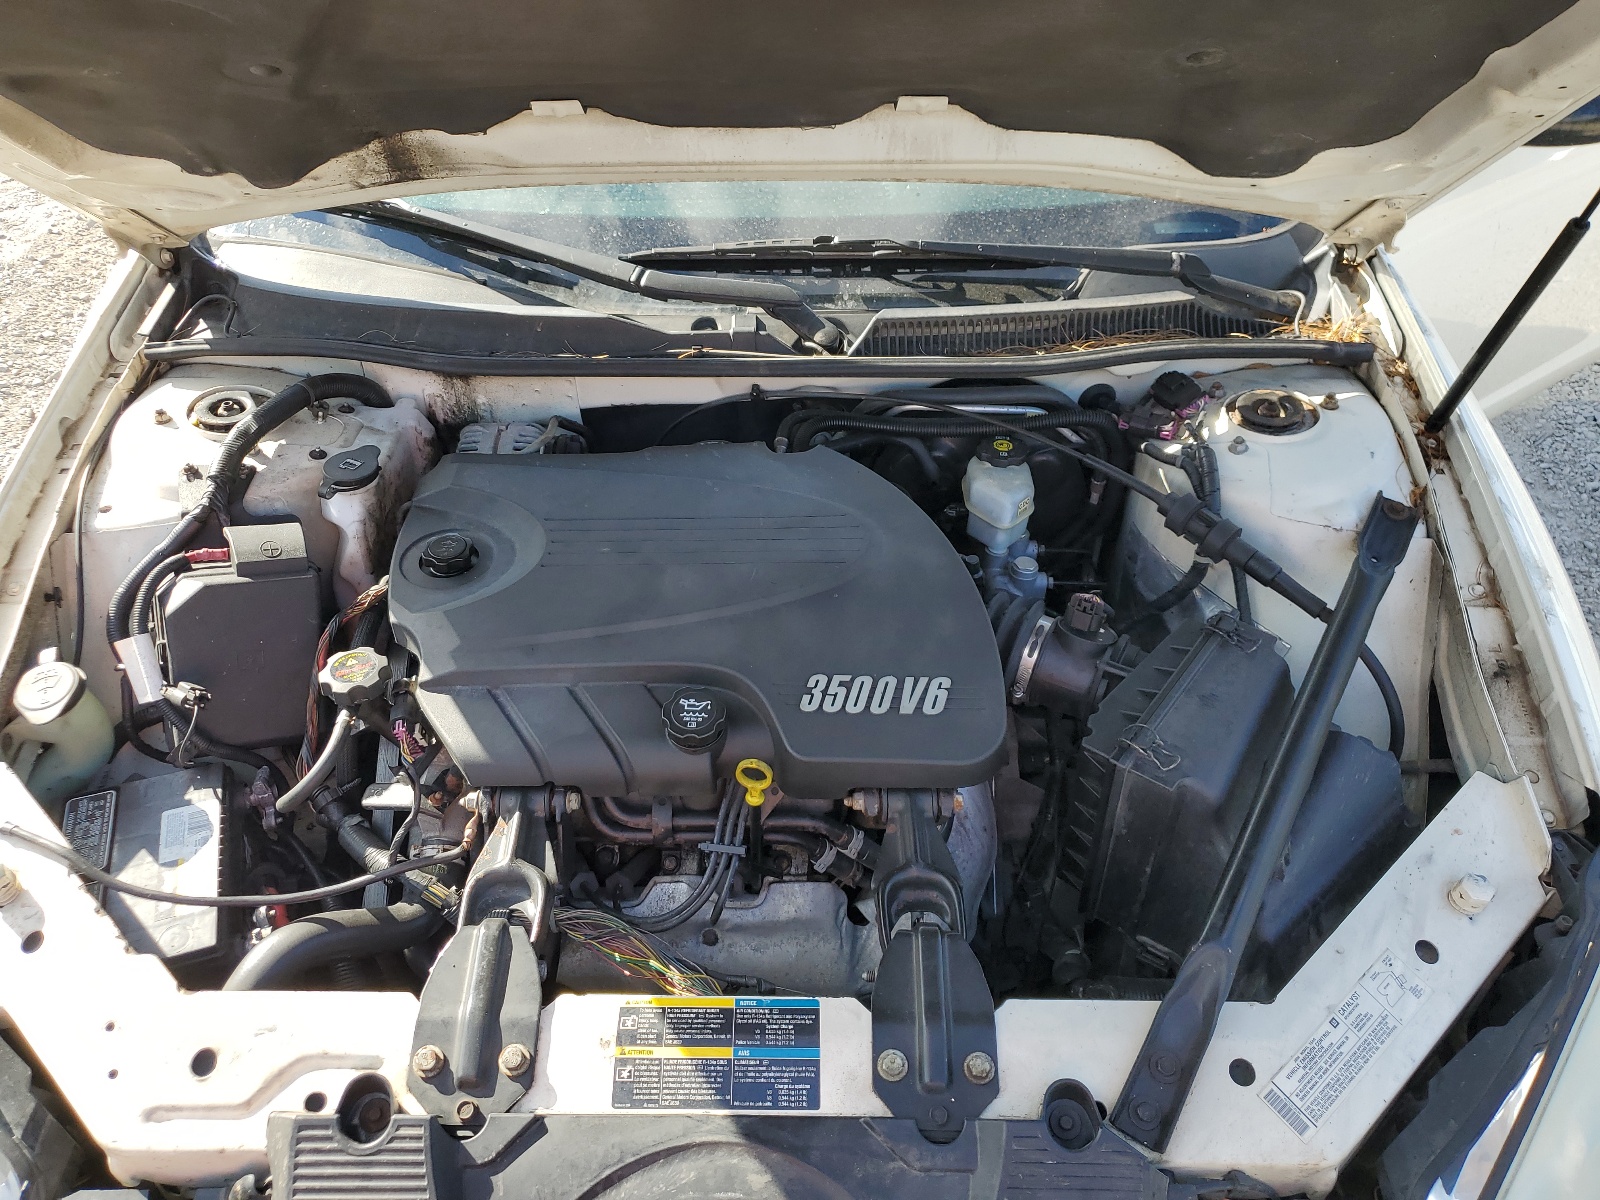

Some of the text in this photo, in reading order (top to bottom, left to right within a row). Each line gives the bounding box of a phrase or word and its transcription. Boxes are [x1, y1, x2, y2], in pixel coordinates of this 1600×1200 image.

[799, 673, 951, 715] 3500 V6
[1338, 991, 1362, 1017] CATALYST
[1286, 1063, 1302, 1081] VEHICLE
[1299, 1045, 1317, 1065] EMISSION
[1315, 1029, 1332, 1048] CONTROL
[1302, 1045, 1325, 1071] INFORMATION
